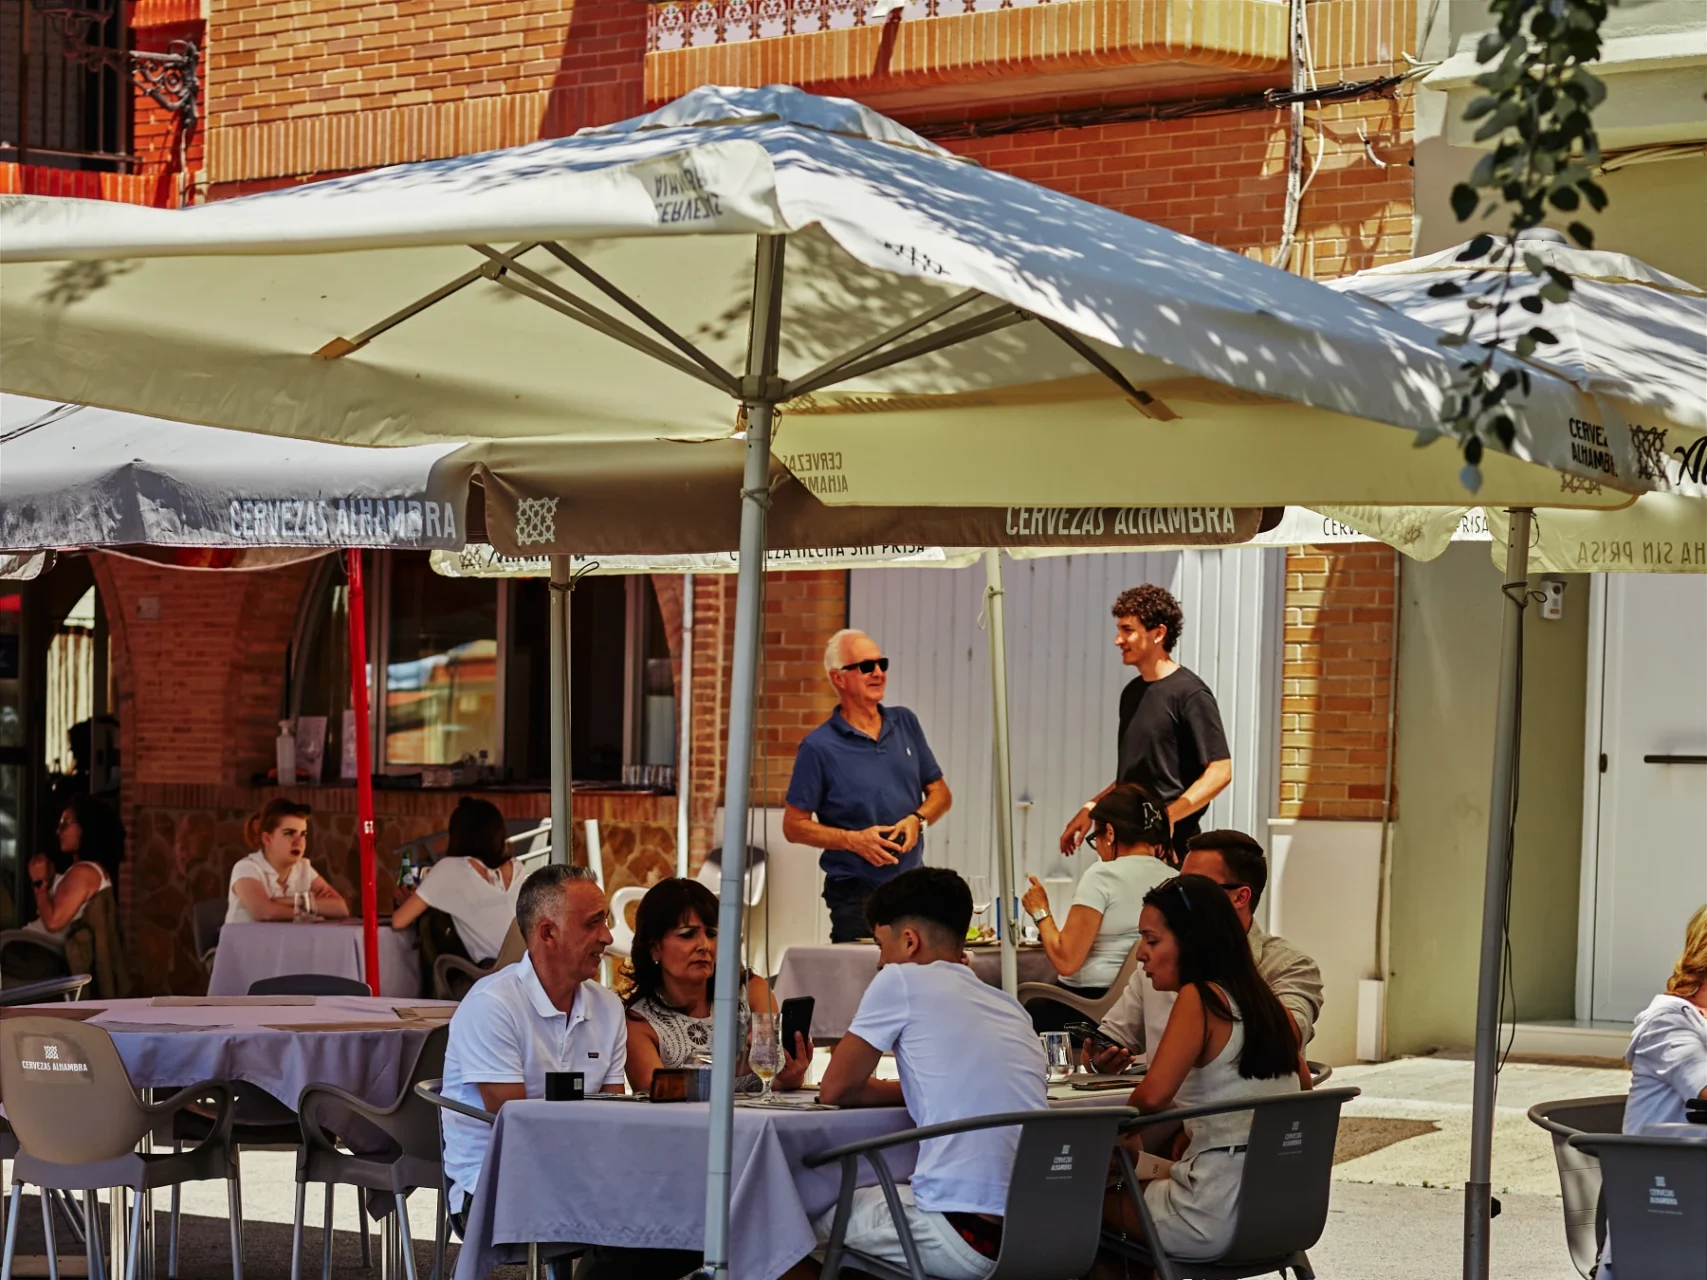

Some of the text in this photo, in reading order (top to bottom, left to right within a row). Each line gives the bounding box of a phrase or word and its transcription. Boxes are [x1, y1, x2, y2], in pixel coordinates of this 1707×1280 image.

[1571, 441, 1619, 478] ALHAMB
[230, 499, 457, 539] CERVEZAS ALHAMBRA
[1005, 507, 1236, 535] CERVEZAS ALHAMBRA
[1456, 515, 1489, 534] RISA
